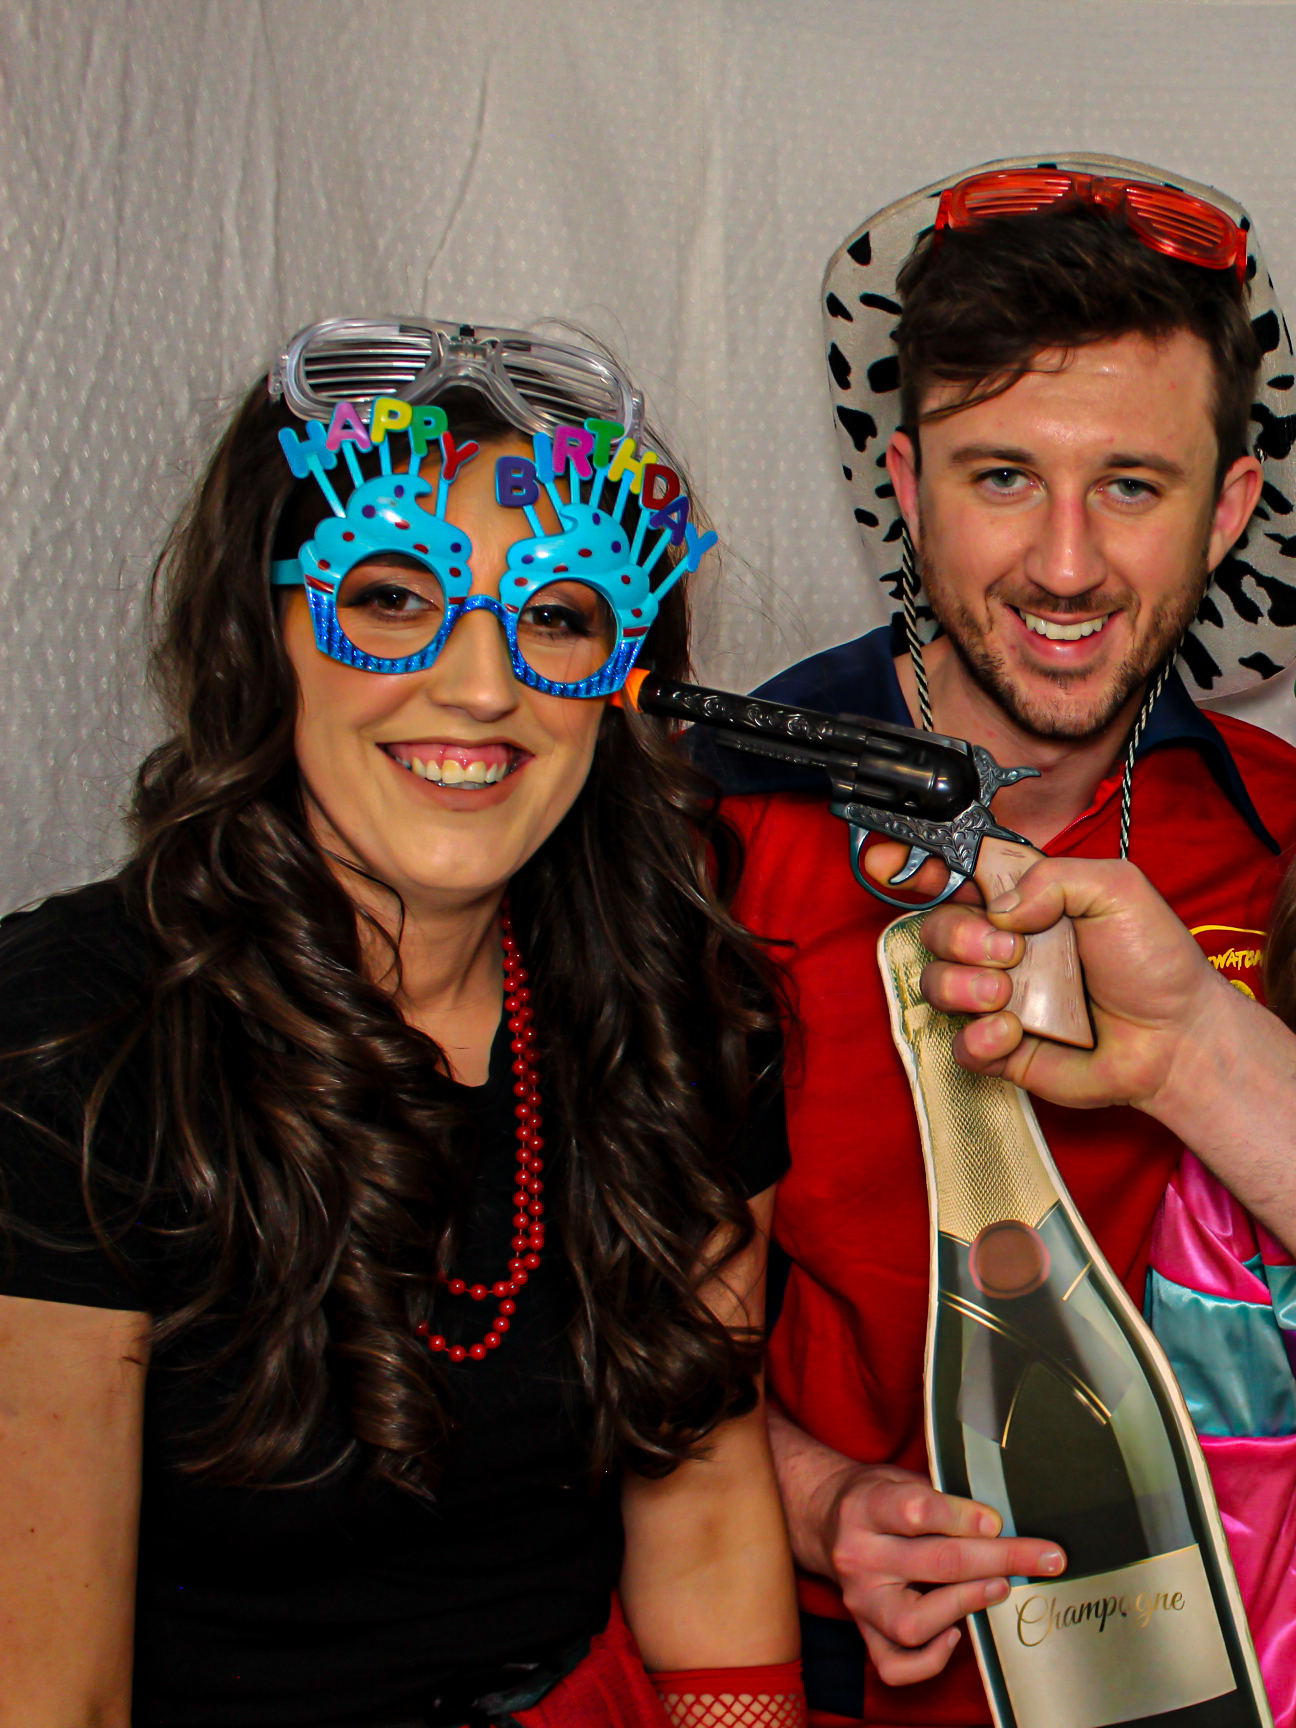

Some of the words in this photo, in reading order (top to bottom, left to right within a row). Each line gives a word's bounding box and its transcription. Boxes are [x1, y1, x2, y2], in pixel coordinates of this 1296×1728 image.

[278, 396, 479, 482] HAPPY
[495, 418, 718, 572] BIRTHDAY
[1015, 1591, 1186, 1647] Champagne
